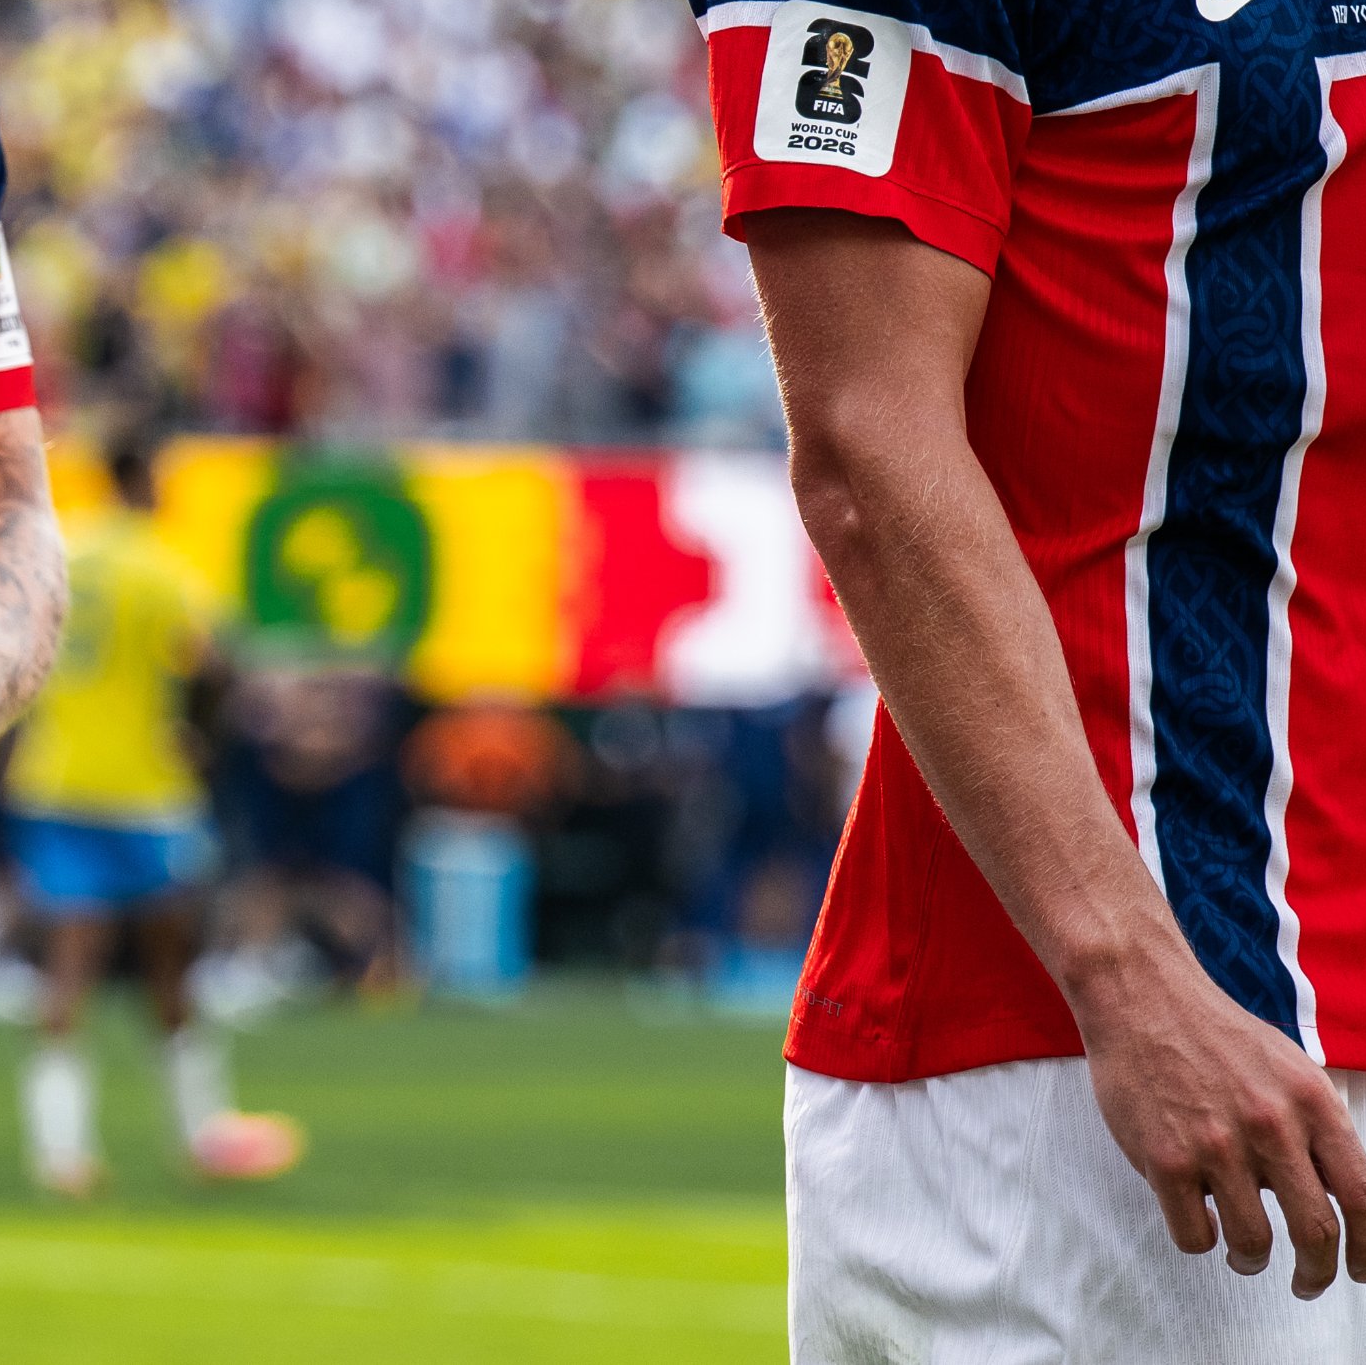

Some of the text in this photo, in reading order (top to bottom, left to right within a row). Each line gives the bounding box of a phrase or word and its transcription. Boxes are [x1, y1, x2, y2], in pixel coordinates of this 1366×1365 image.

[813, 99, 845, 116] FIFA
[791, 122, 858, 141] WORLD CUP
[787, 134, 856, 156] 2026
